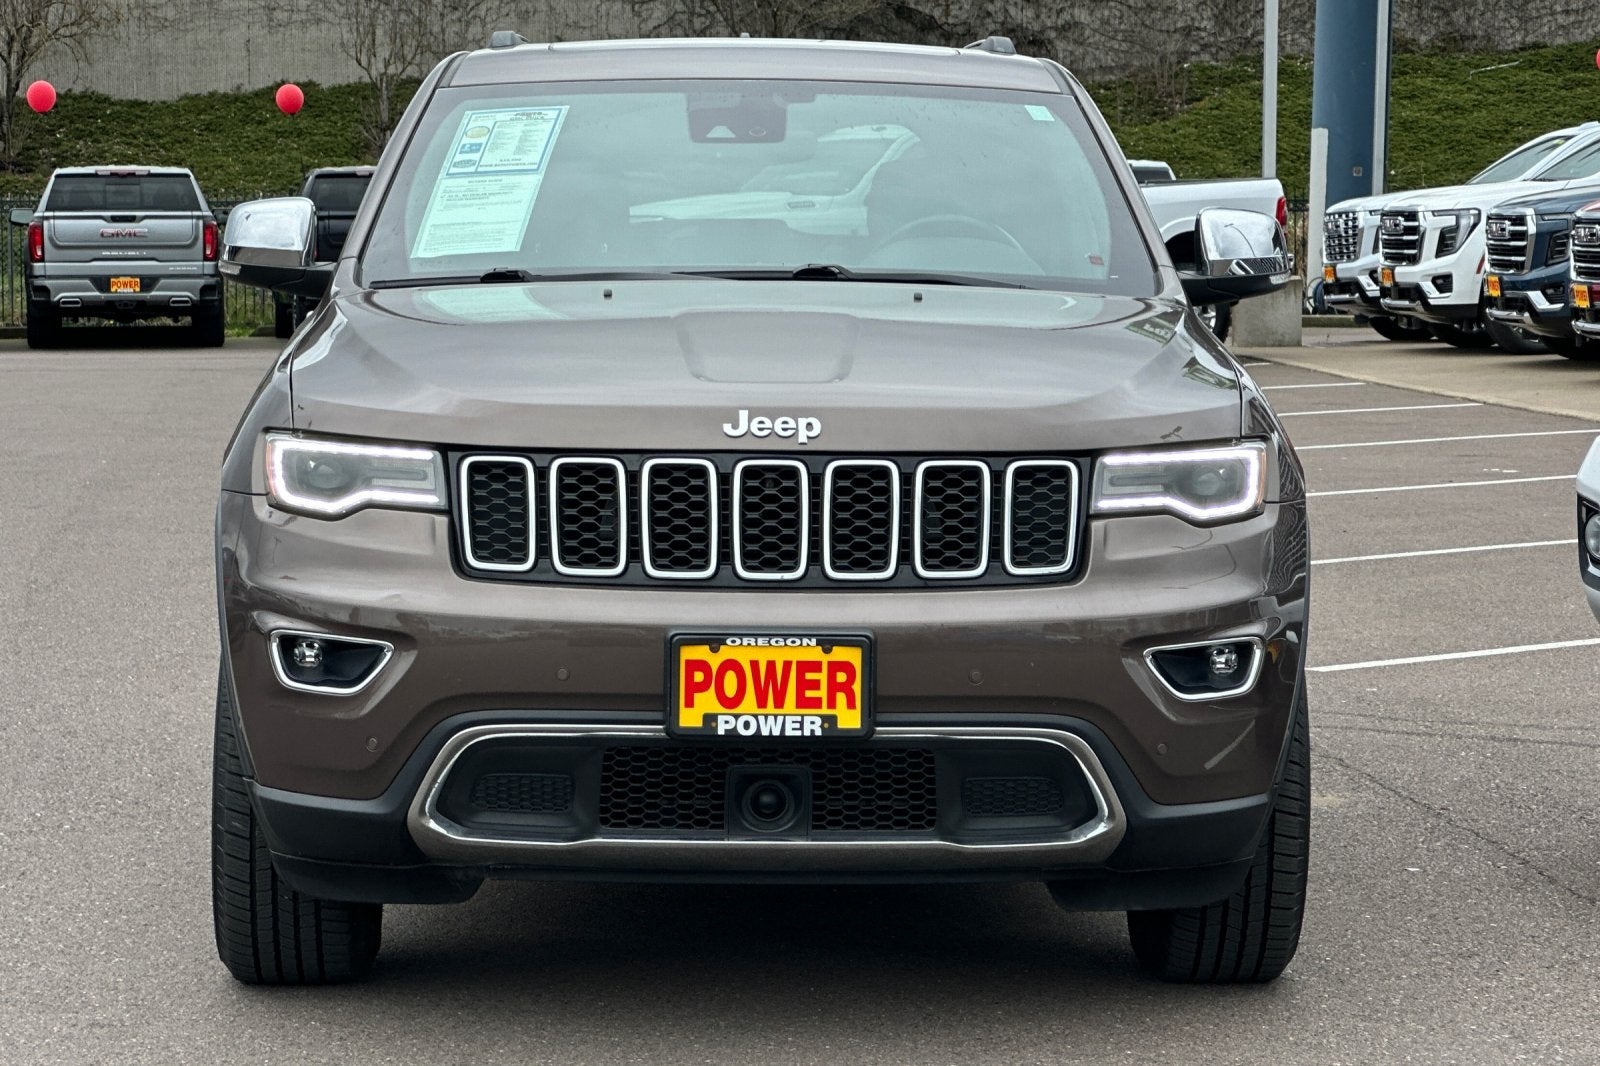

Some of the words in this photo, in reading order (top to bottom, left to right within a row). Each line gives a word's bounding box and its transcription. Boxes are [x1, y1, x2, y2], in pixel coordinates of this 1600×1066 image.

[100, 228, 148, 238] GMC
[112, 280, 139, 289] POWER
[722, 409, 822, 444] Jeep
[725, 637, 817, 647] OREGON
[684, 658, 857, 709] POWER
[717, 715, 822, 736] POWER
